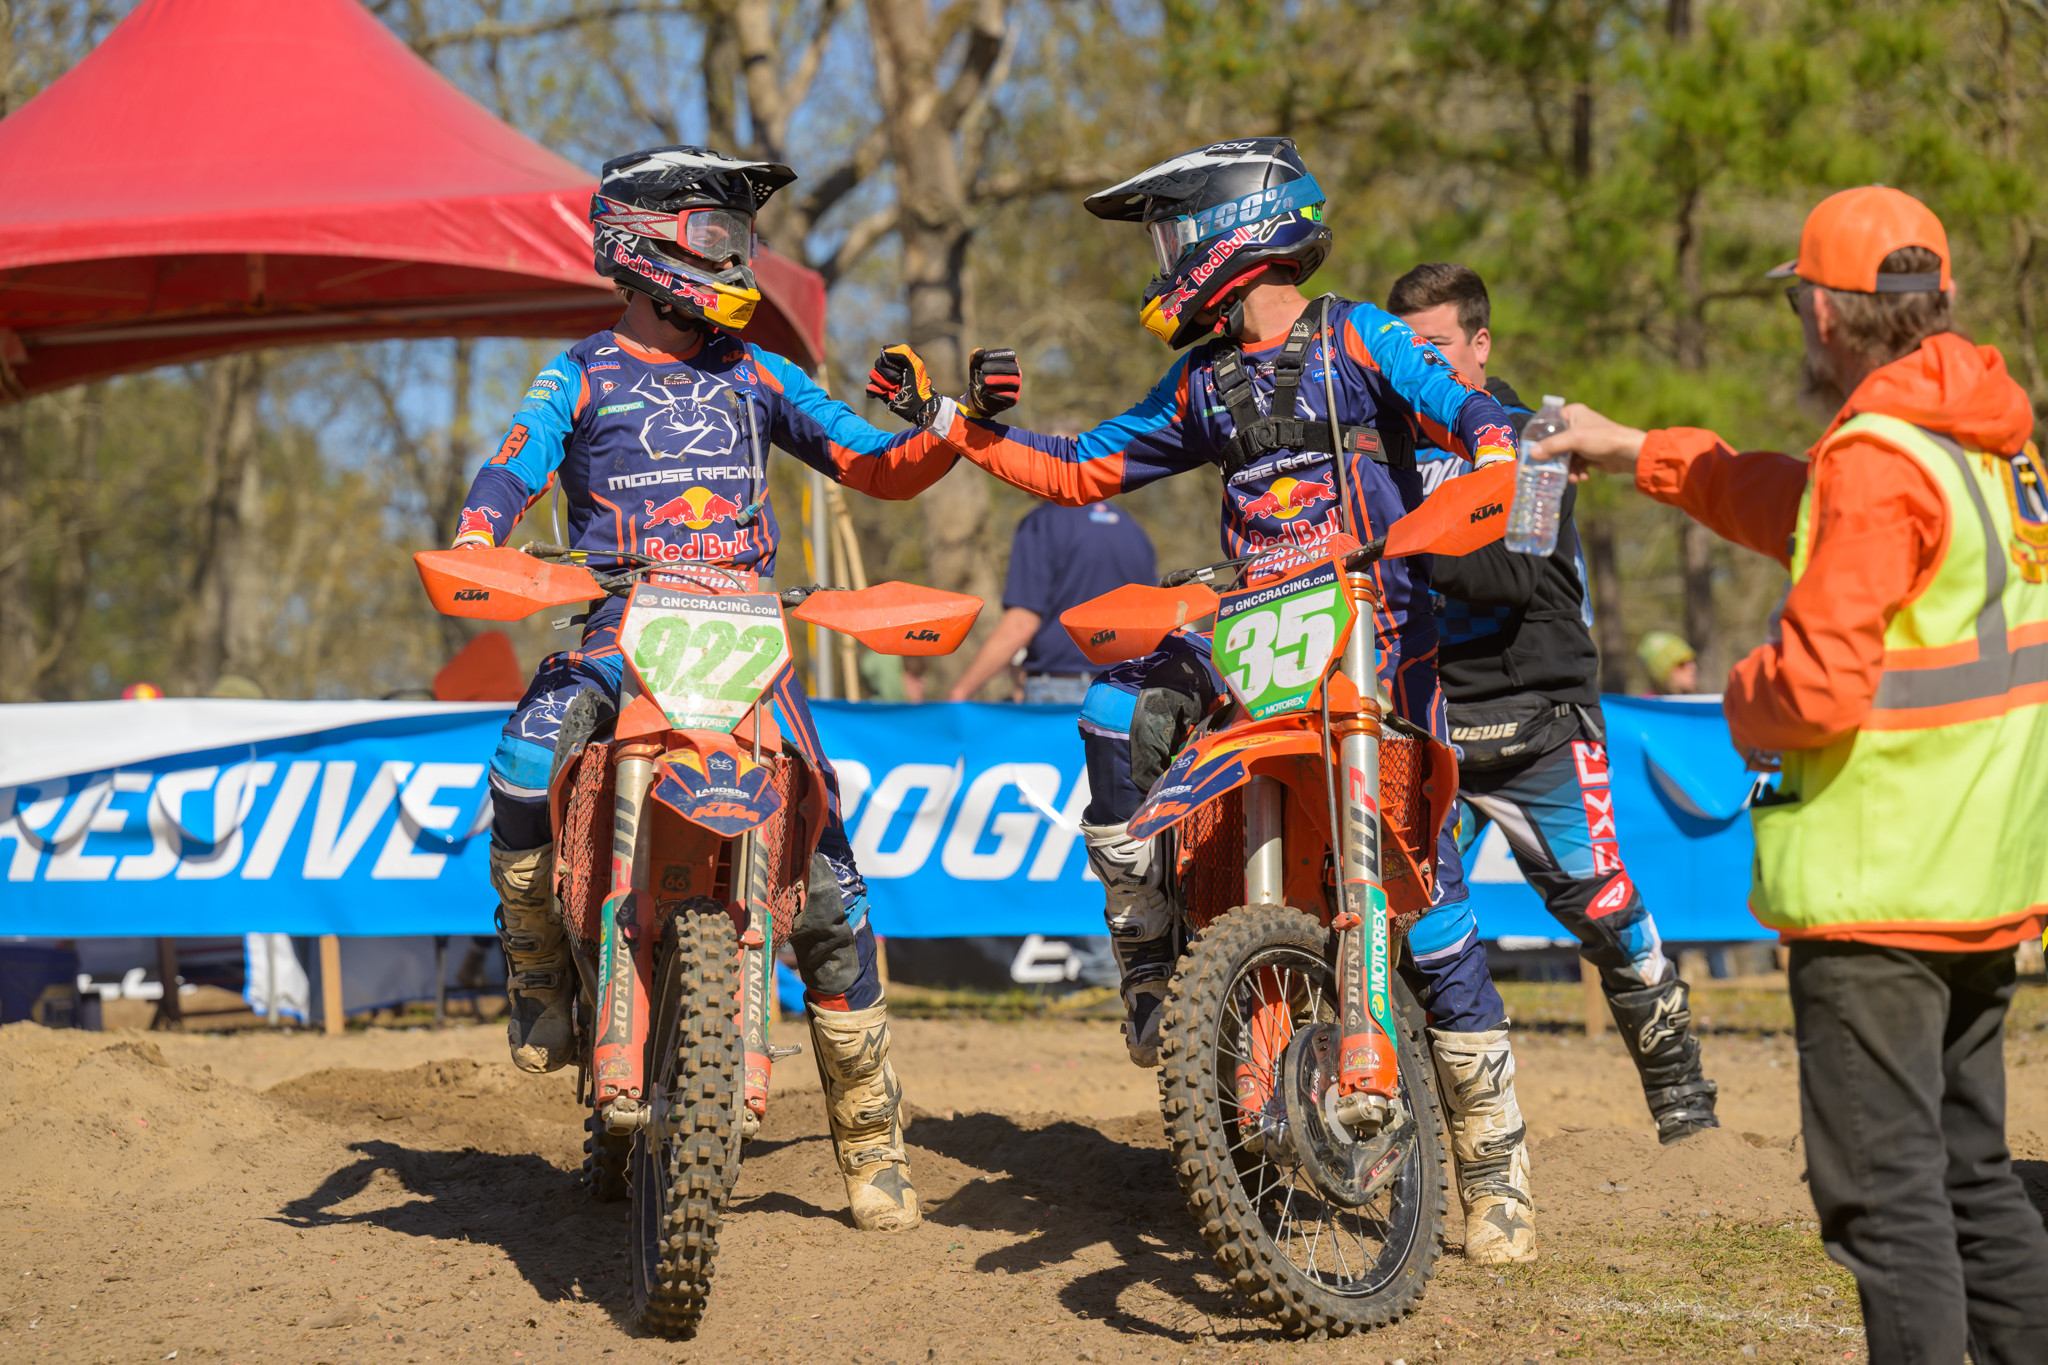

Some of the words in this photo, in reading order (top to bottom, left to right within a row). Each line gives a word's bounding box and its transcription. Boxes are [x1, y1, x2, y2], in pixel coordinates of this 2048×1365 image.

[1197, 185, 1294, 237] 100%
[613, 242, 643, 273] Red
[640, 258, 674, 289] Bull
[1188, 248, 1225, 286] Red
[1214, 226, 1253, 259] Bull
[607, 402, 642, 413] MOTOREX
[489, 423, 531, 465] KTM
[1247, 522, 1295, 554] Red
[1293, 505, 1343, 546] Bull
[1470, 503, 1503, 523] KTM
[645, 533, 699, 562] Red
[702, 529, 753, 560] Bull
[1250, 546, 1331, 581] RENTHAL
[454, 589, 489, 601] KTM
[661, 597, 777, 616] GNCCRACING.COM
[1235, 573, 1334, 612] GNCCRACING.COM
[905, 629, 940, 642] KTM
[1091, 629, 1117, 647] KTM
[1225, 588, 1337, 705] 35
[634, 616, 784, 703] 922
[1265, 695, 1304, 714] MOTOREX
[1451, 722, 1518, 741] USWE
[695, 787, 750, 798] LANDERS
[690, 802, 760, 822] KTM
[1347, 893, 1360, 1006] DUNLP
[1371, 907, 1386, 993] MOTOREX
[748, 912, 763, 1026] DUNLP
